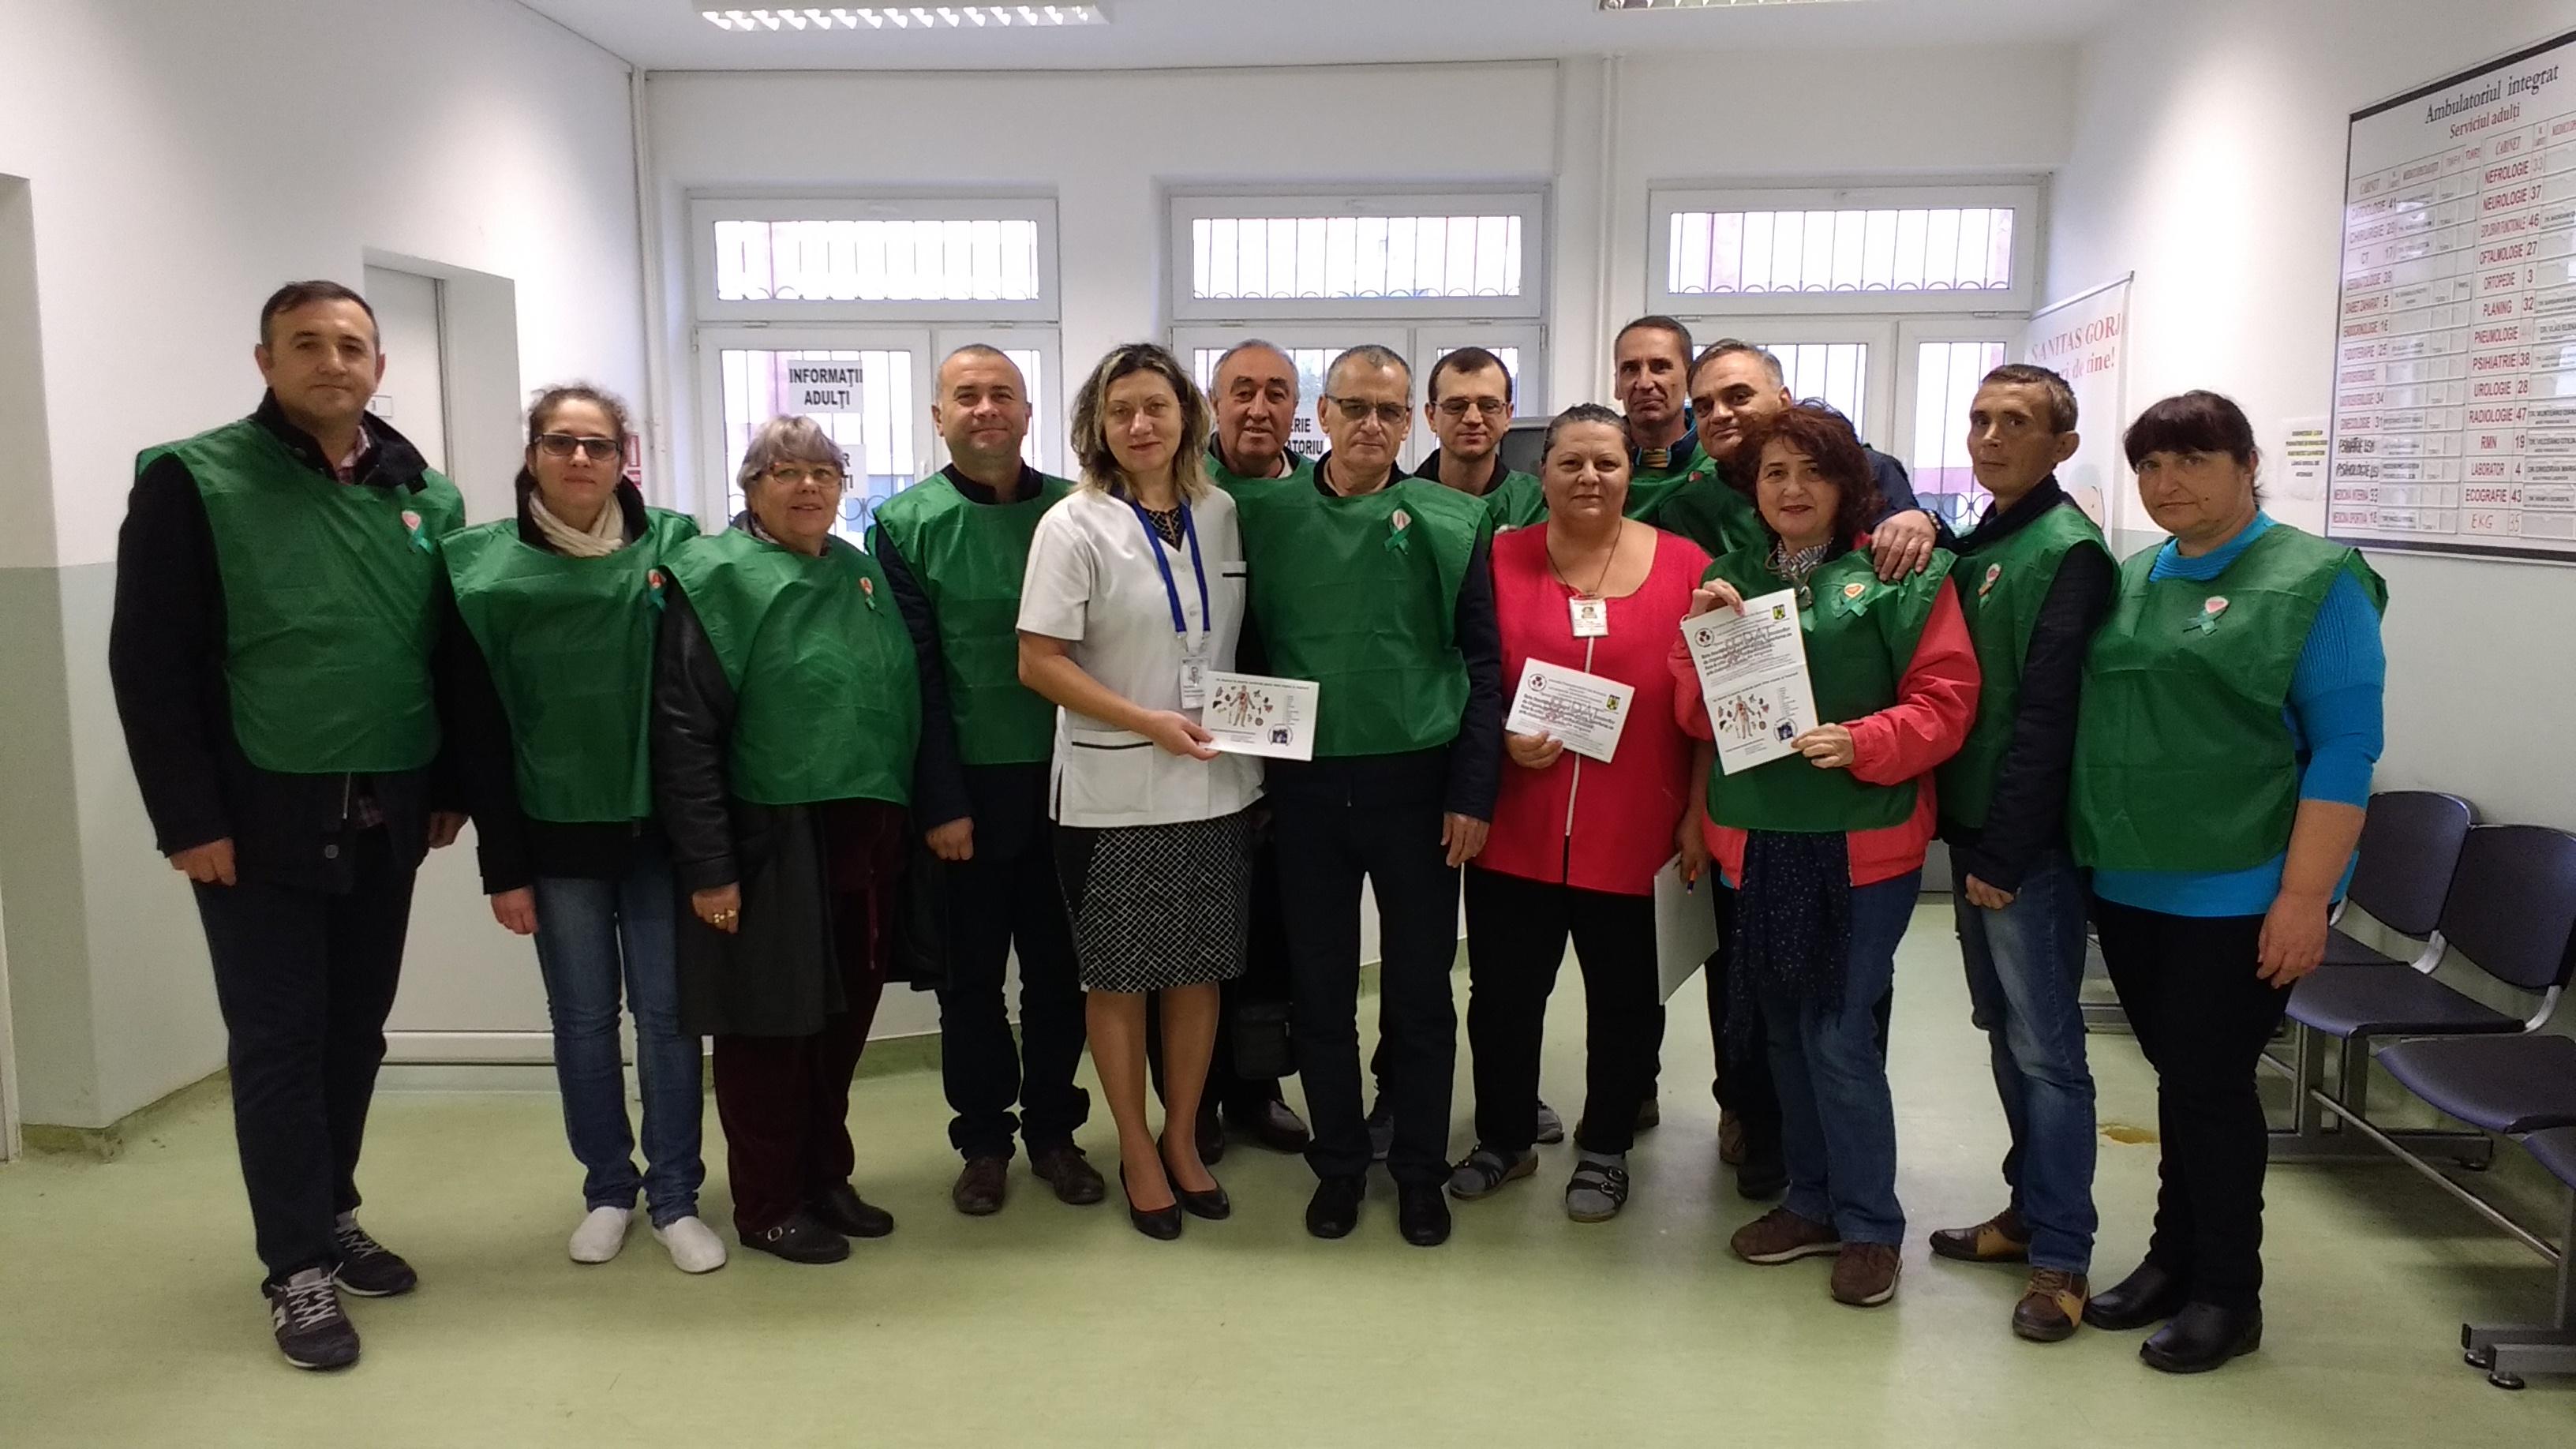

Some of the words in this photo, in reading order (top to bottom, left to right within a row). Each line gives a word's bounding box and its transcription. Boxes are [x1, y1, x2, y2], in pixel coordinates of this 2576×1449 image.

[2424, 80, 2501, 124] Ambulatoriul
[2507, 65, 2559, 95] integrat
[2450, 111, 2489, 139] Serviciul
[2484, 160, 2529, 184] NEFROLOGIE
[2483, 188, 2527, 212] NEUROLOGIE
[2530, 185, 2541, 200] 37
[2529, 213, 2540, 227] 46
[2479, 243, 2523, 265] OFTALMOLOGIE
[2526, 242, 2537, 256] 27
[2484, 272, 2515, 290] ORTOPEDIE
[2527, 269, 2533, 283] 3
[2483, 300, 2512, 317] PLANING
[2523, 297, 2534, 311] 32
[2031, 328, 2082, 363] SANITAS
[2085, 313, 2121, 344] GORJ
[2474, 326, 2518, 344] PNEUMOLOGIE
[2072, 358, 2084, 379] de
[2087, 346, 2115, 374] tine!
[2473, 353, 2516, 370] PSIHIATRIE
[2519, 352, 2530, 366] 38
[789, 369, 863, 388] INFORMAȚII
[2474, 381, 2511, 397] UROLOGIE
[2518, 380, 2528, 395] 28
[804, 390, 850, 410] ADULȚI
[2469, 408, 2513, 423] RADIOLOGIE
[2516, 407, 2527, 421] 47
[1291, 418, 1311, 432] RIE
[1287, 440, 1324, 454] ATORIU
[2481, 436, 2496, 449] RMN
[2515, 435, 2525, 449] 19
[2471, 462, 2504, 476] LABORATOR
[2515, 462, 2521, 476] 4
[2466, 489, 2507, 503] ECOGRAFIE
[2511, 489, 2522, 503] 43
[2471, 514, 2493, 529] EKG
